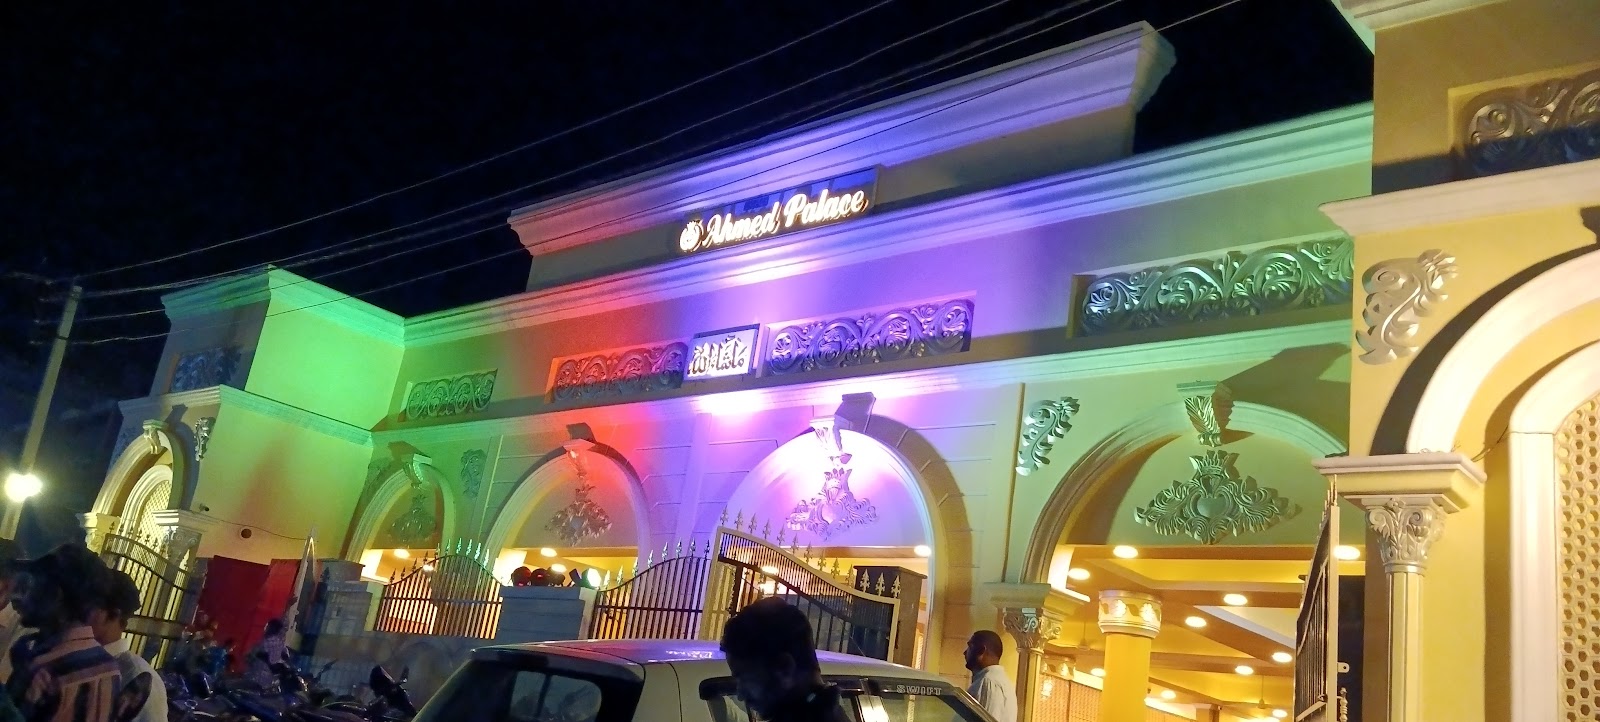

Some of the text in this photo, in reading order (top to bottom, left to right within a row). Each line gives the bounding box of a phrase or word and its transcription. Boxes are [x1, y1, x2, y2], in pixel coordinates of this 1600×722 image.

[701, 188, 867, 247] Ahmed Palace
[896, 684, 942, 696] SWIFT
